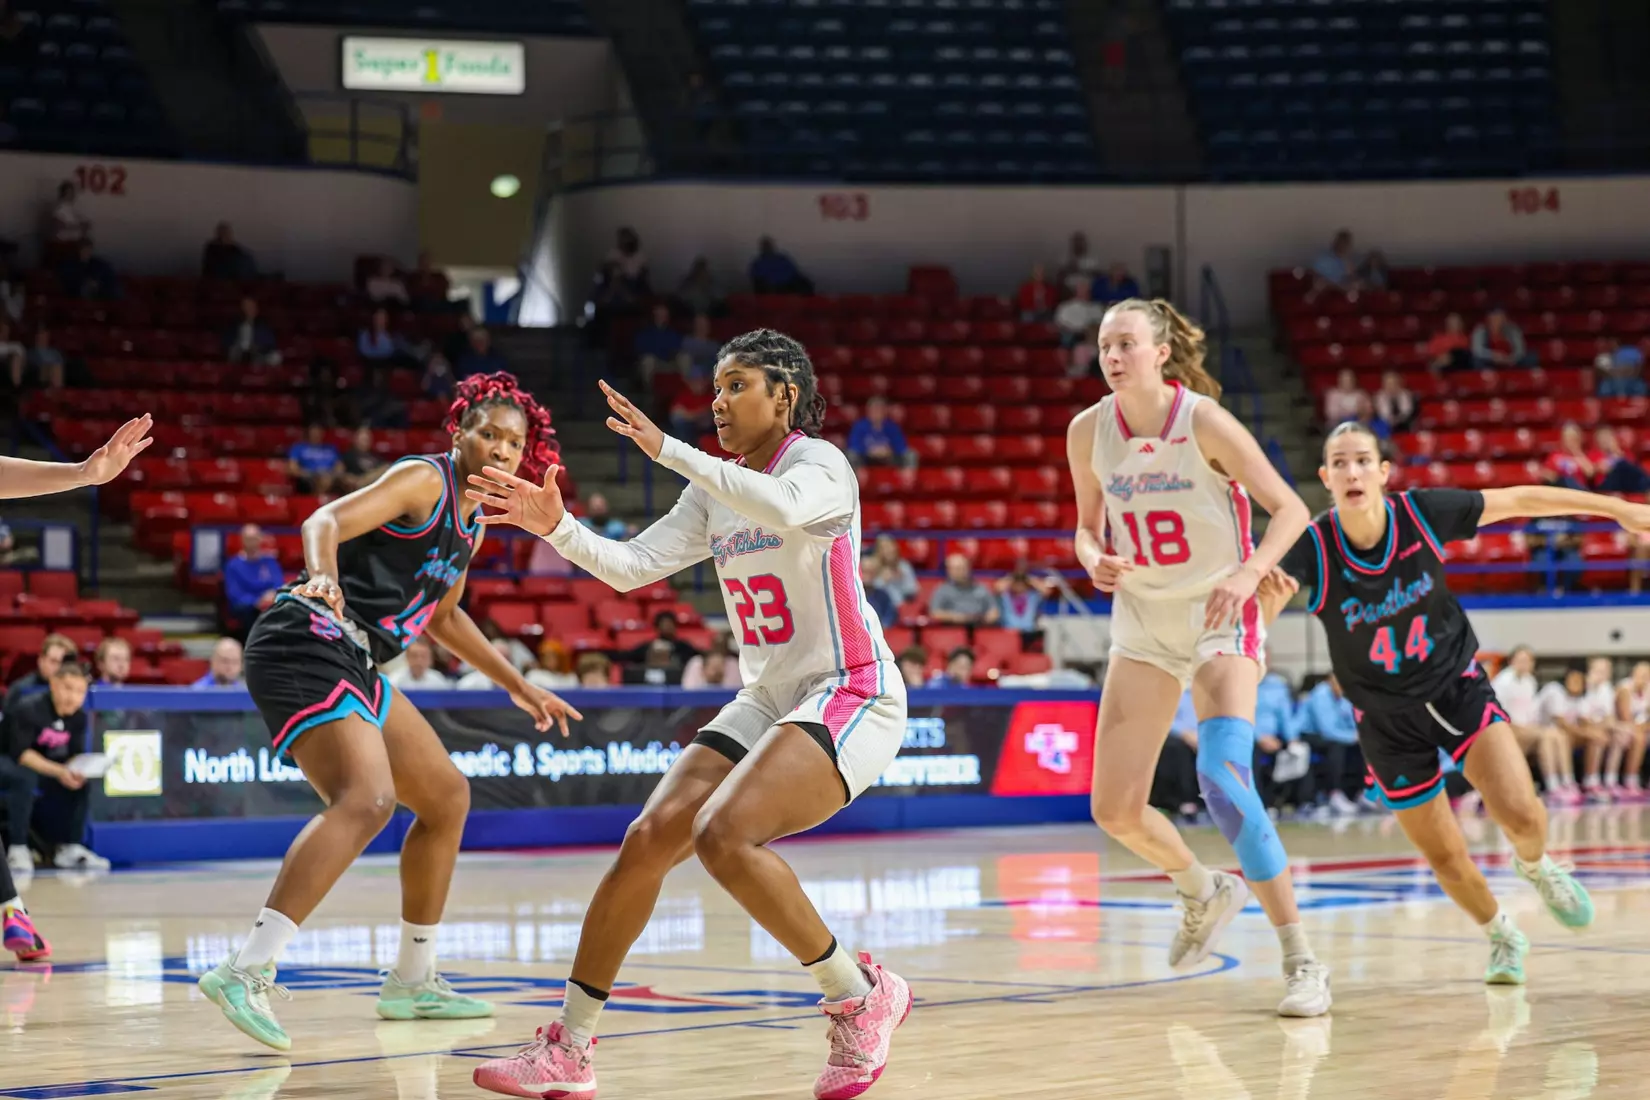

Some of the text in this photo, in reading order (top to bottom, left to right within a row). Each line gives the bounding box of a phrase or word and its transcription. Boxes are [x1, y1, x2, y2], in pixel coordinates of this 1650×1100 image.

[74, 164, 127, 196] 102
[1508, 186, 1561, 214] 104
[1122, 510, 1192, 567] 18
[723, 573, 795, 647] 23
[1340, 570, 1434, 632] Panthers
[1369, 614, 1435, 674] 44
[184, 747, 255, 783] North
[512, 742, 535, 777] &
[536, 742, 605, 783] Sports
